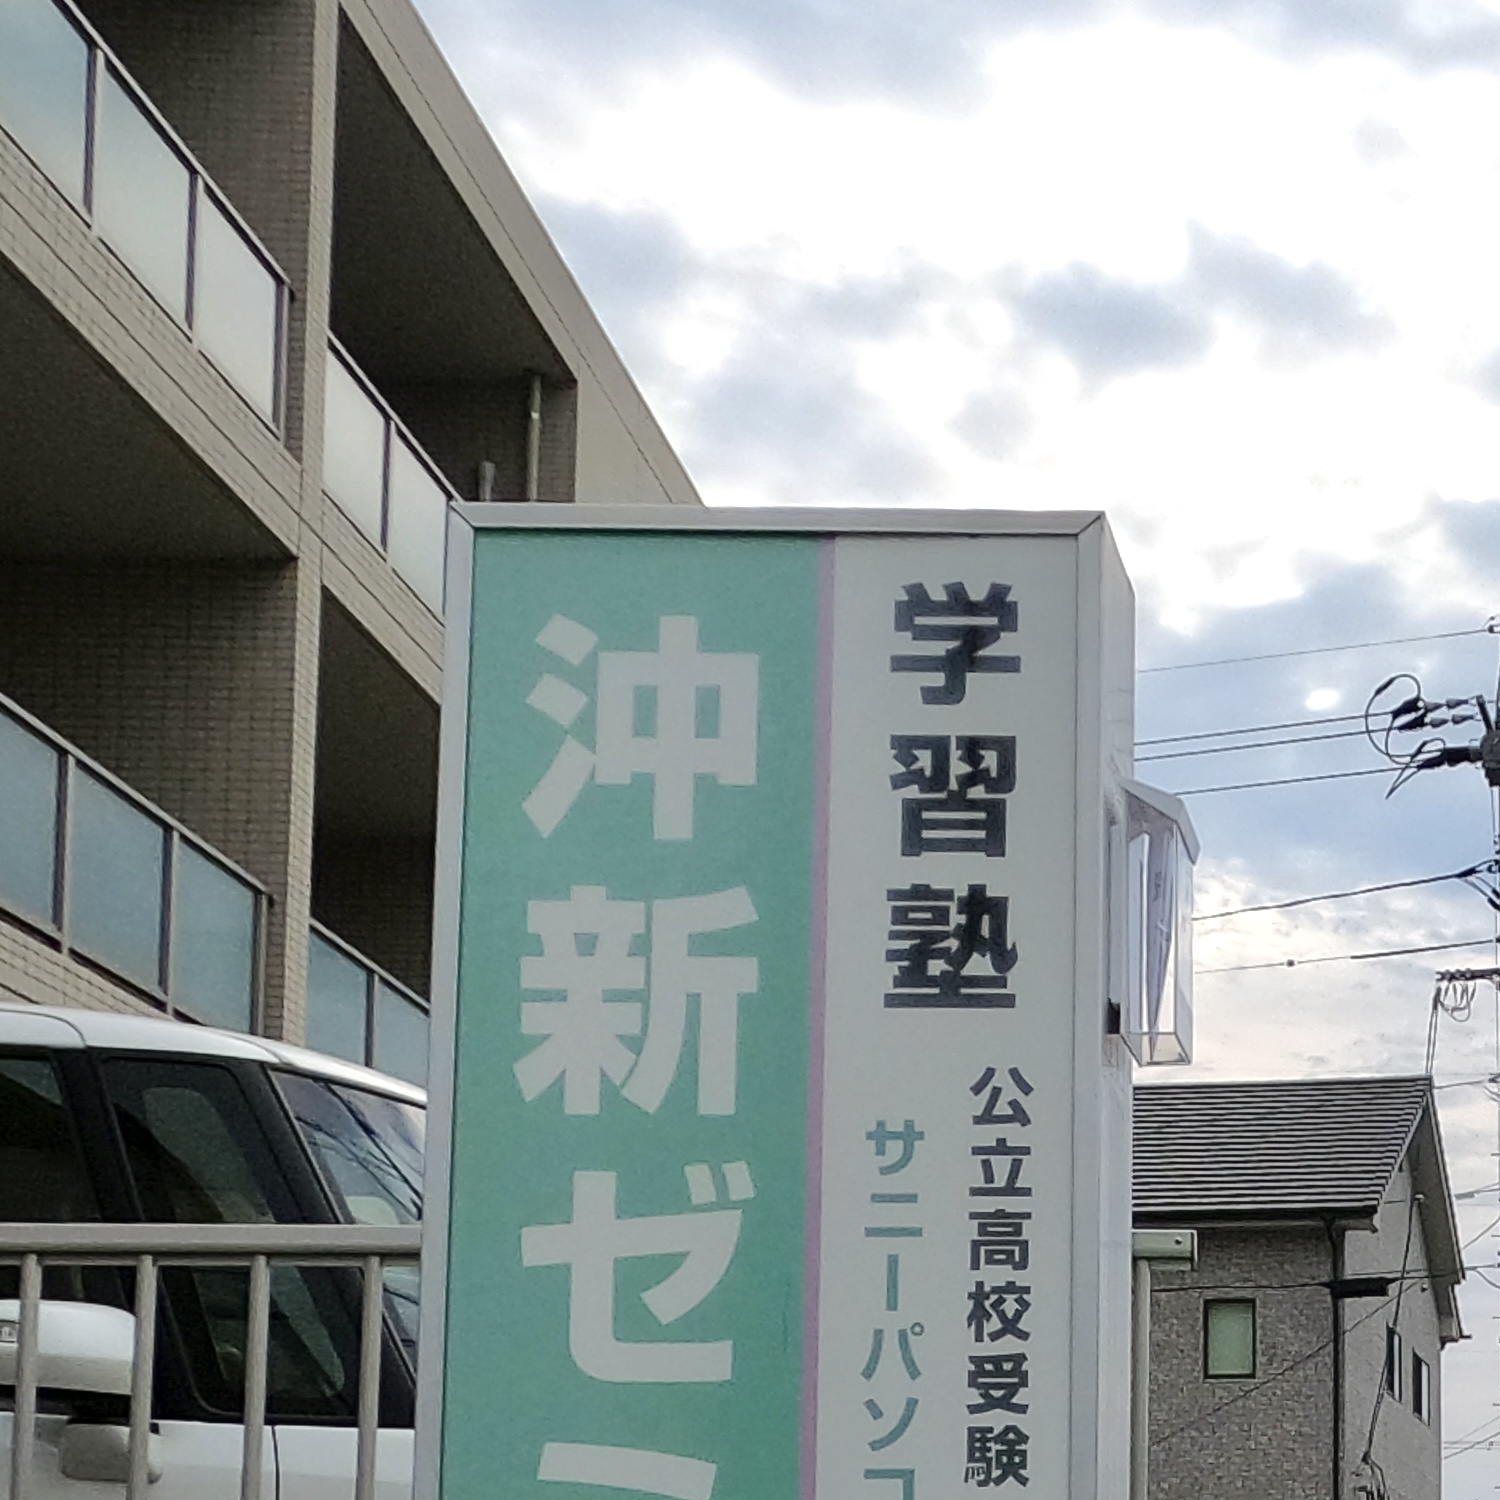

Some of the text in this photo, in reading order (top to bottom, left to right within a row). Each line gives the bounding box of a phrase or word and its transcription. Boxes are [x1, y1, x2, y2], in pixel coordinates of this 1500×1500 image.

[884, 581, 1021, 1009] 学習塾
[964, 1066, 1035, 1488] 公立高校受験
